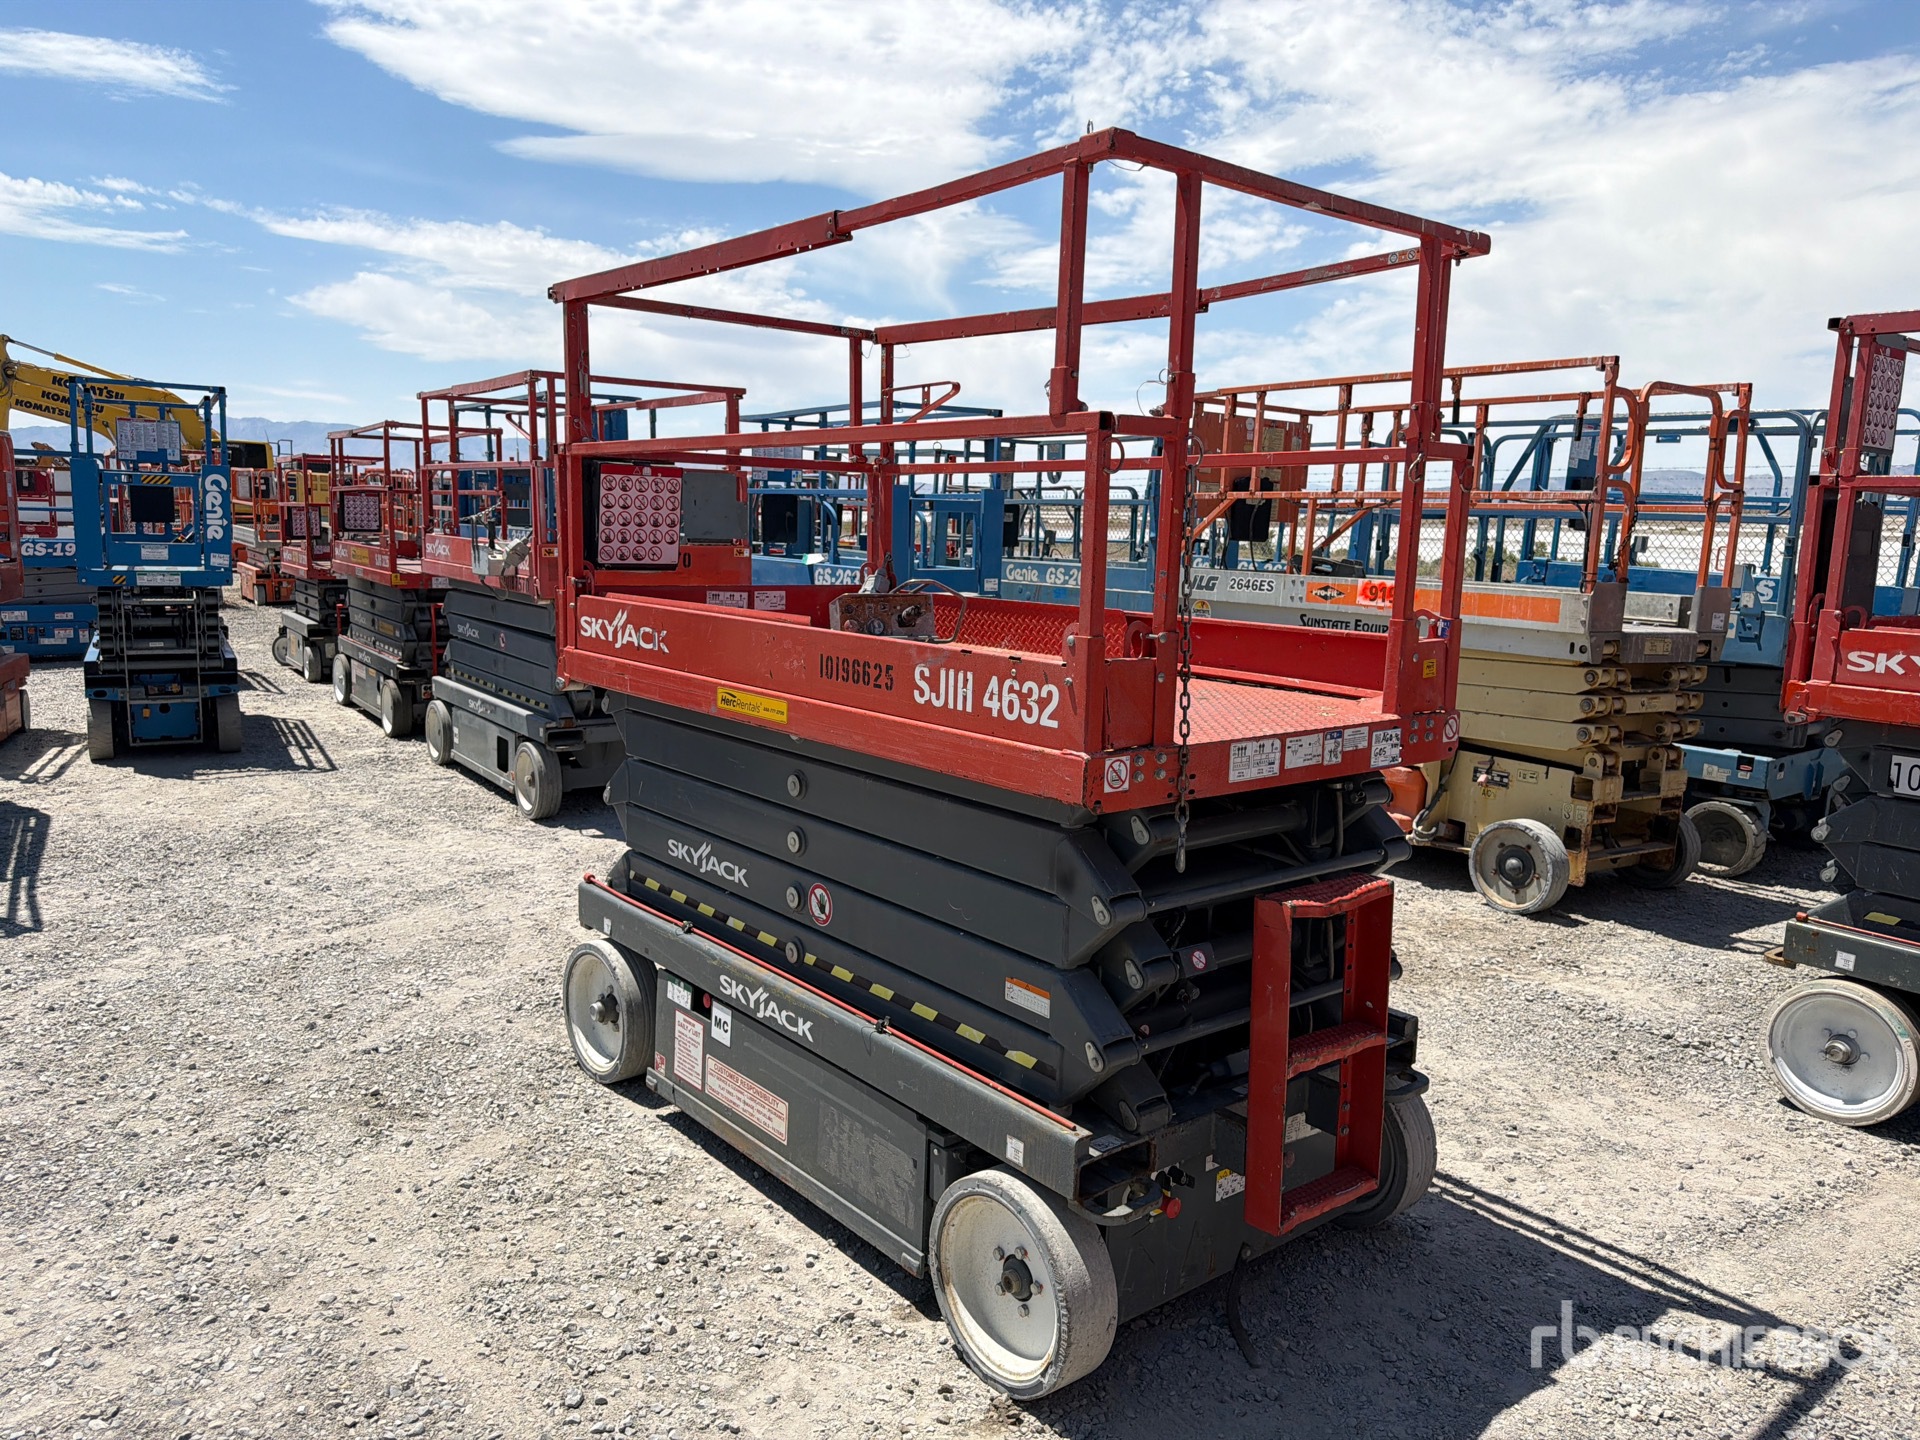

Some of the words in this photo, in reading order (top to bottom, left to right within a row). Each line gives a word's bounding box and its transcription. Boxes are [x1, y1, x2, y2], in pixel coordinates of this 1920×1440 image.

[204, 473, 228, 541] Genie
[21, 542, 76, 557] GS-19
[426, 539, 450, 556] SKYJACK
[1006, 563, 1038, 582] Genie
[1046, 567, 1081, 586] GS-2
[1229, 577, 1275, 592] 2646ES
[580, 609, 670, 654] SKYJACK
[819, 653, 894, 692] 10196625
[1846, 650, 1920, 677] SK
[720, 692, 762, 714] HercRentals
[983, 675, 1060, 729] 4632
[667, 838, 750, 888] SKYJACK
[714, 1015, 729, 1034] MC
[719, 974, 814, 1043] SKYJACK
[713, 1063, 740, 1084] CUSTOMER
[740, 1079, 780, 1109] RESPONSIBILITY
